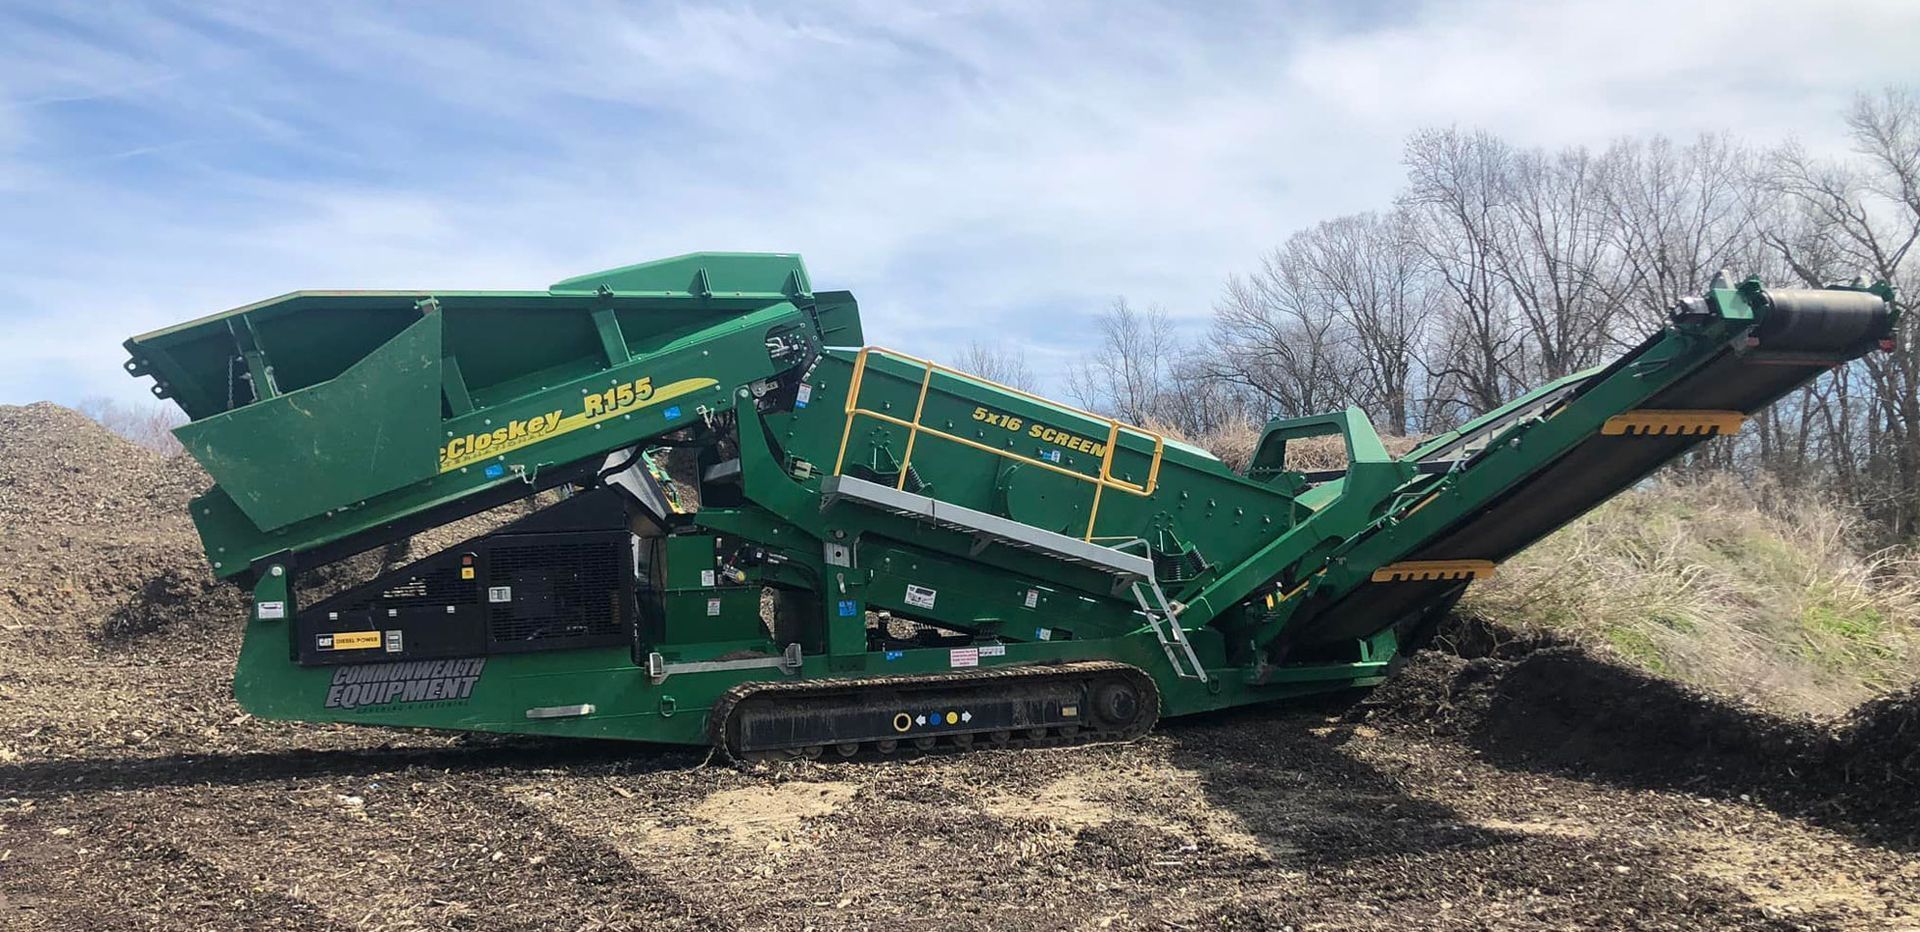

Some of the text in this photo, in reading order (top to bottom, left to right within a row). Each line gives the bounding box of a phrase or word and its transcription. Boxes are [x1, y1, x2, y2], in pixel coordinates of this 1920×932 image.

[584, 376, 654, 418] R155
[439, 409, 563, 463] cCloskey
[972, 406, 1108, 458] 5x16 SCREEN
[332, 656, 487, 685] COMMONWEALTH
[324, 677, 480, 710] EQUIPMENT
